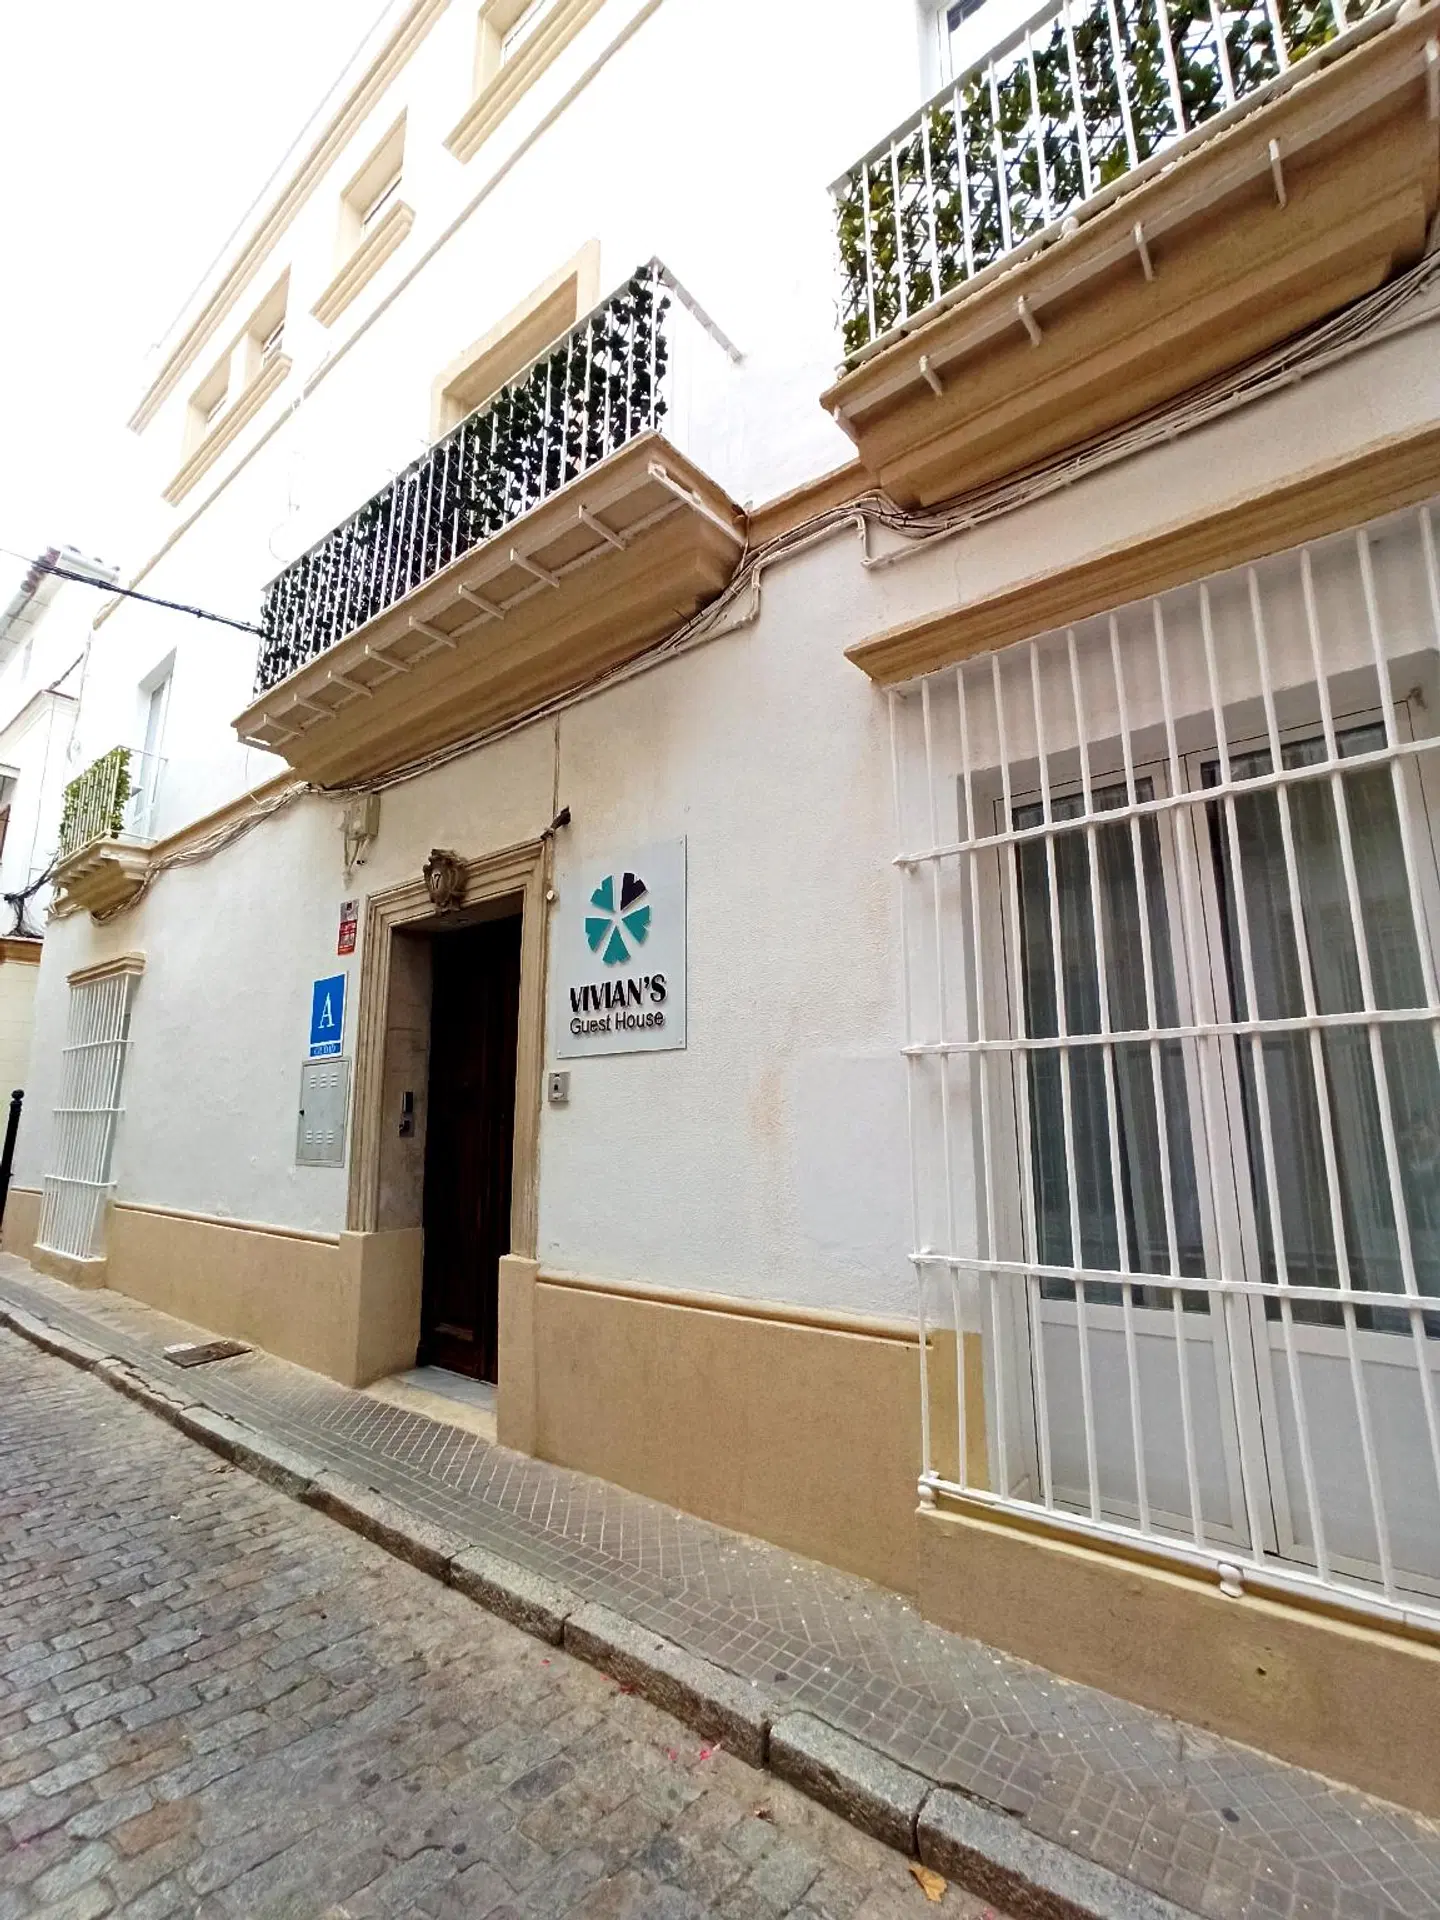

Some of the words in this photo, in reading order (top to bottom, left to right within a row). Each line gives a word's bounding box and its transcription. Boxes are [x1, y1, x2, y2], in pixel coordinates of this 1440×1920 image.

[318, 992, 336, 1029] A
[570, 974, 666, 1012] VIVIAN'S
[570, 1014, 611, 1034] Guest
[615, 1011, 664, 1030] House
